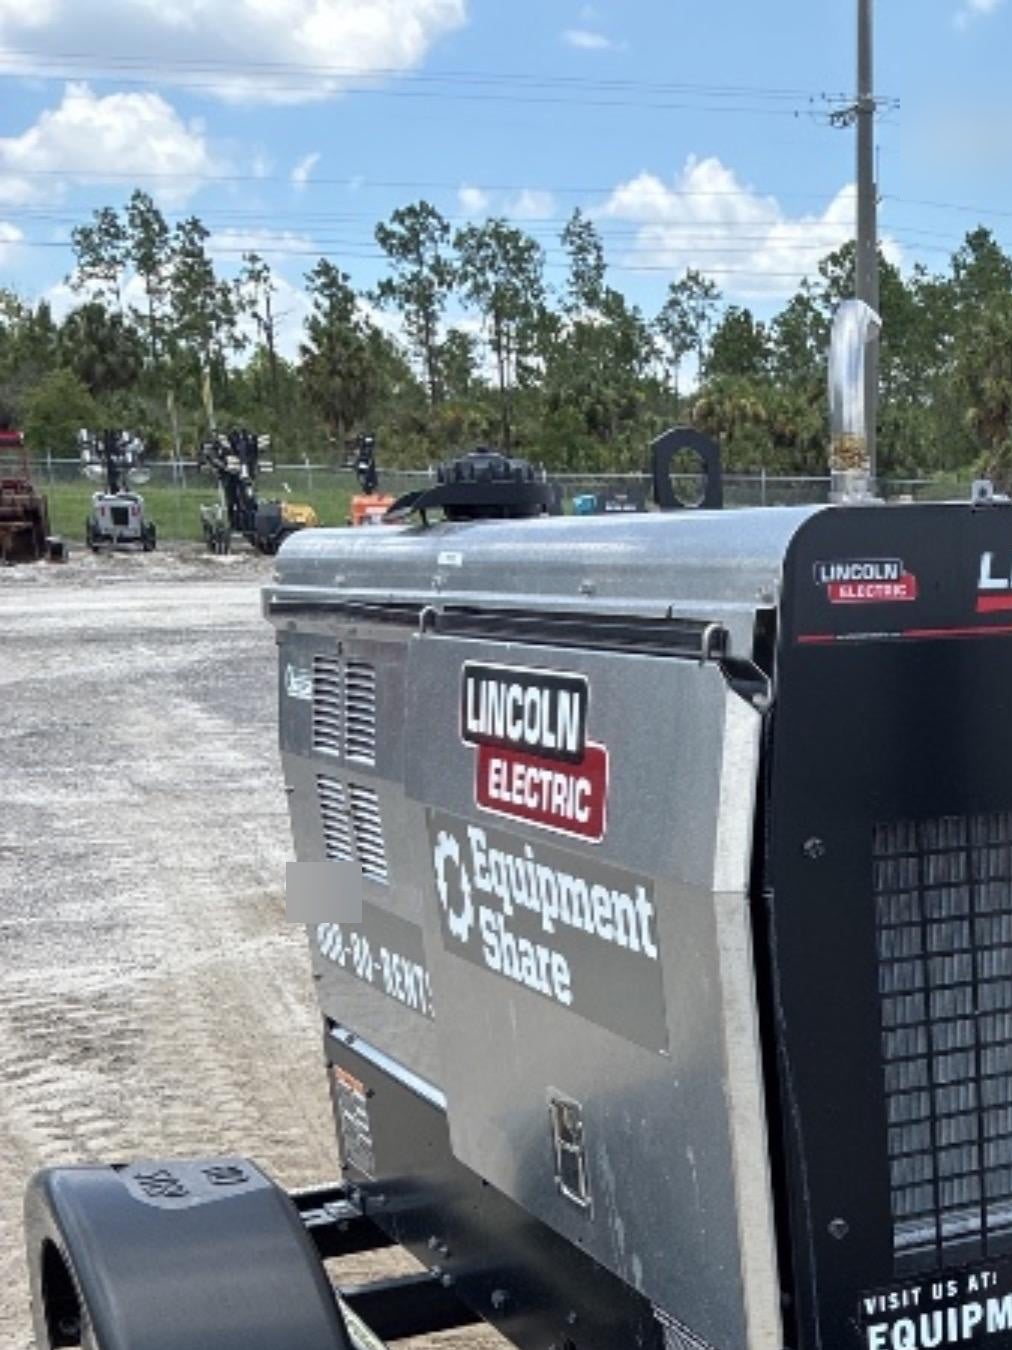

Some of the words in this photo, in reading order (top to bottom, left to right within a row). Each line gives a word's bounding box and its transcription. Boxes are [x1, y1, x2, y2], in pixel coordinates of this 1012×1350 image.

[821, 563, 898, 582] LINCOLN
[466, 676, 581, 753] LINCOLN
[488, 757, 592, 824] ELECTRIC
[467, 824, 658, 960] Equipment
[479, 907, 573, 1005] Share
[863, 1287, 922, 1316] VISIT
[932, 1279, 959, 1301] US
